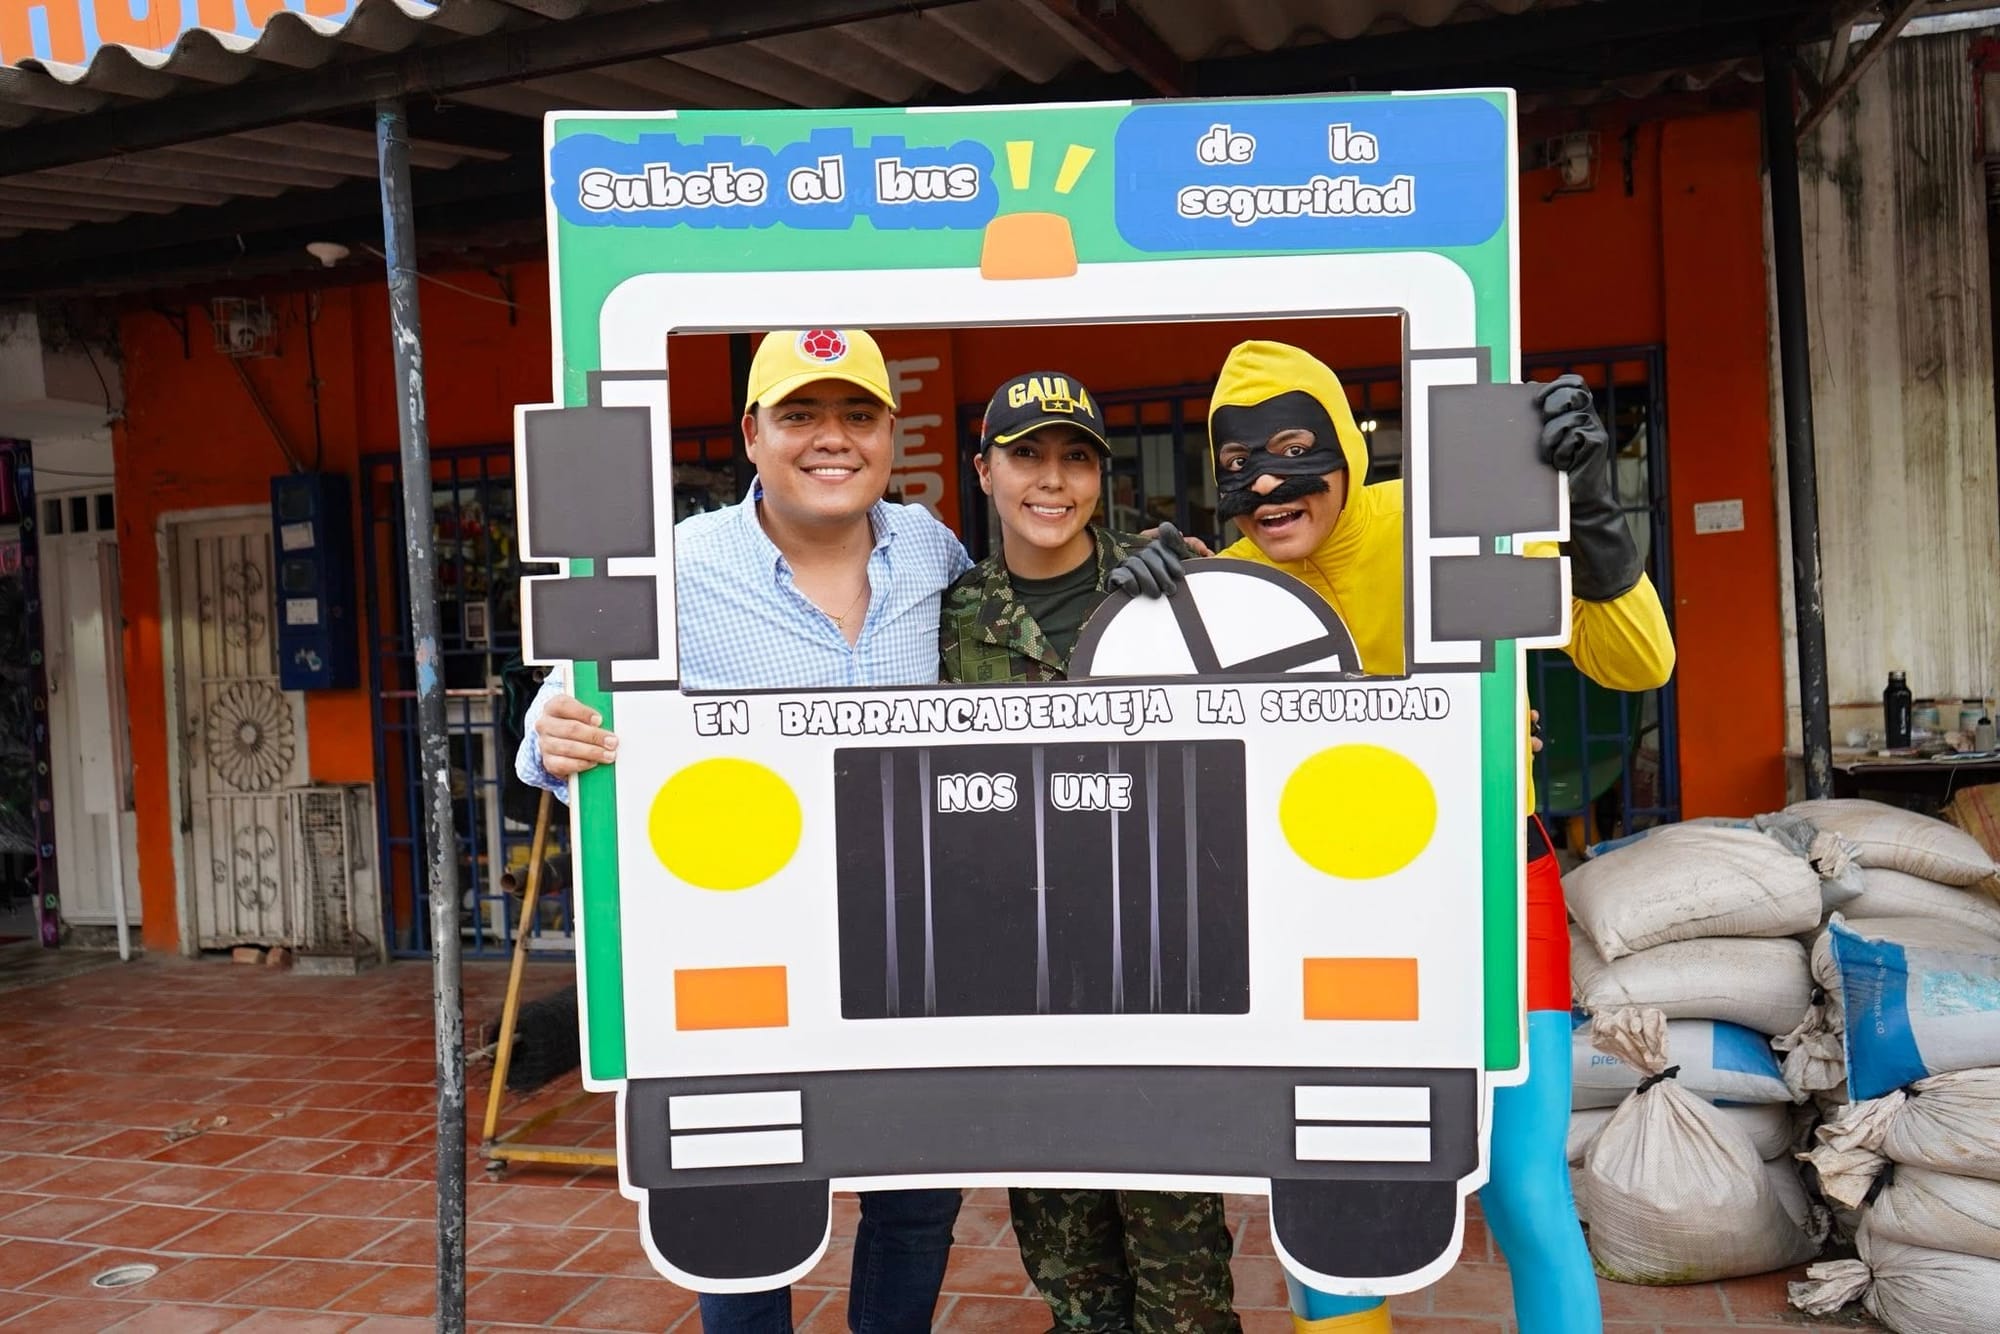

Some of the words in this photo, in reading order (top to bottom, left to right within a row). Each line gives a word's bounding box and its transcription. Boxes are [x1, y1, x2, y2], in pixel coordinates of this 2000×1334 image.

[1197, 124, 1255, 165] de
[1329, 122, 1378, 164] la
[580, 162, 767, 211] Subete
[788, 154, 844, 203] al
[875, 158, 979, 203] bus
[1177, 175, 1415, 226] seguridad
[694, 700, 749, 736] EN
[779, 689, 1173, 736] BARRANCABERMEJA
[1197, 689, 1246, 724] LA
[1260, 687, 1451, 723] SEGURIDAD
[937, 772, 1018, 813] NOS
[1051, 773, 1132, 812] UNE
